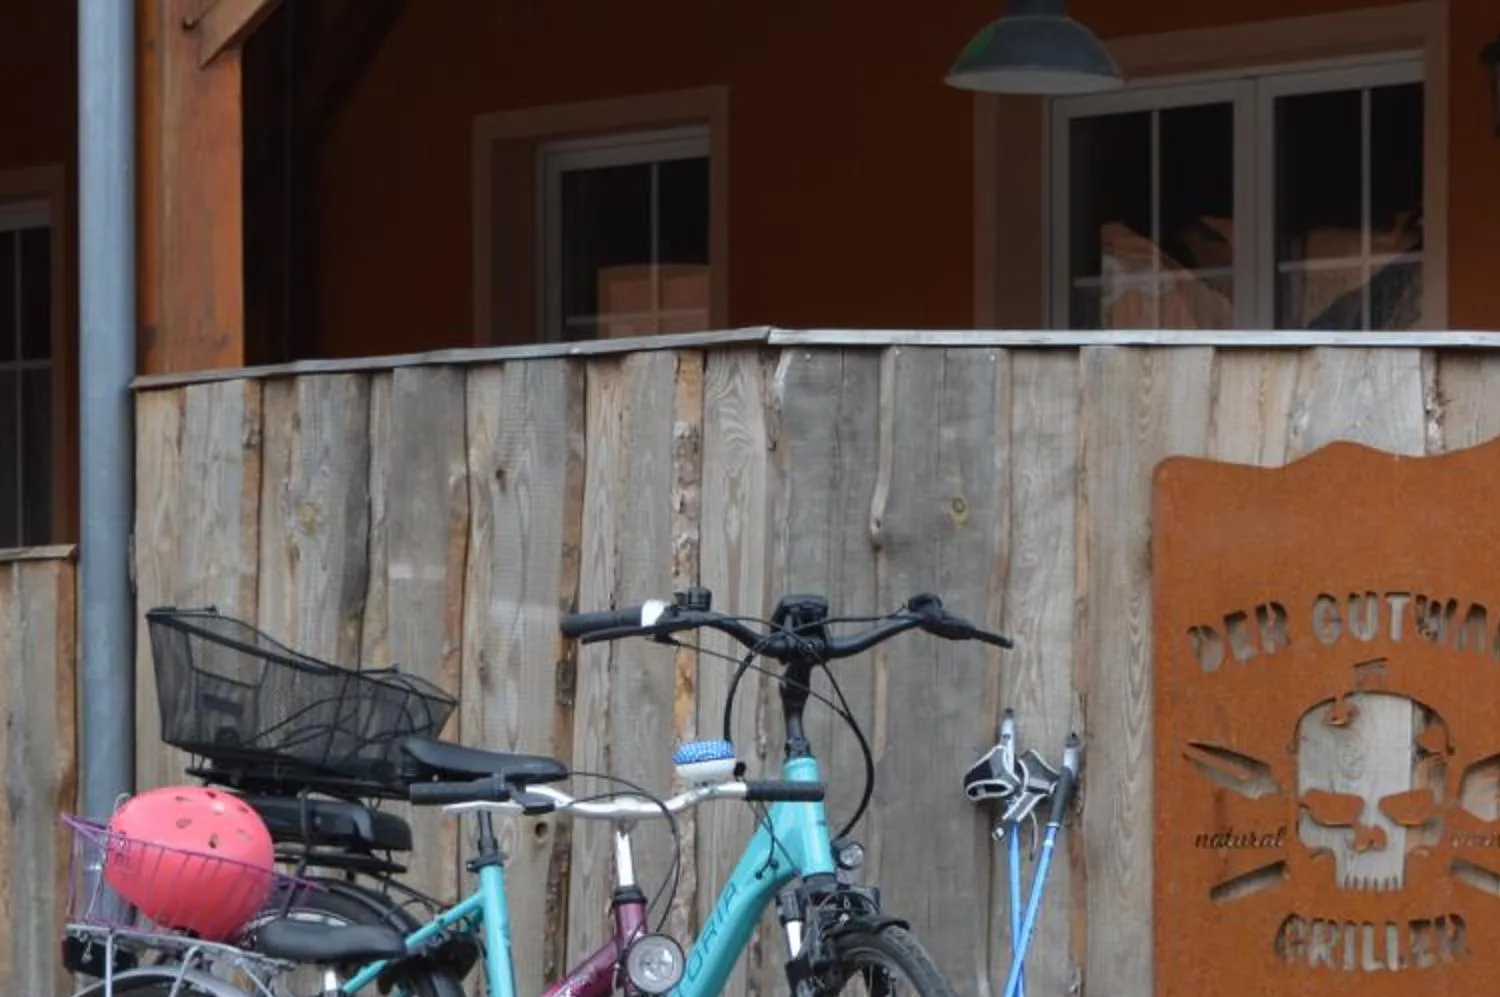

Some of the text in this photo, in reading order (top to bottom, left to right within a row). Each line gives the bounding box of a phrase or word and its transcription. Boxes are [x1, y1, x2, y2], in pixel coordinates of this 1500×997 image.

[1186, 601, 1292, 673] DER
[1195, 824, 1288, 849] natural
[1274, 913, 1471, 972] GRILLER
